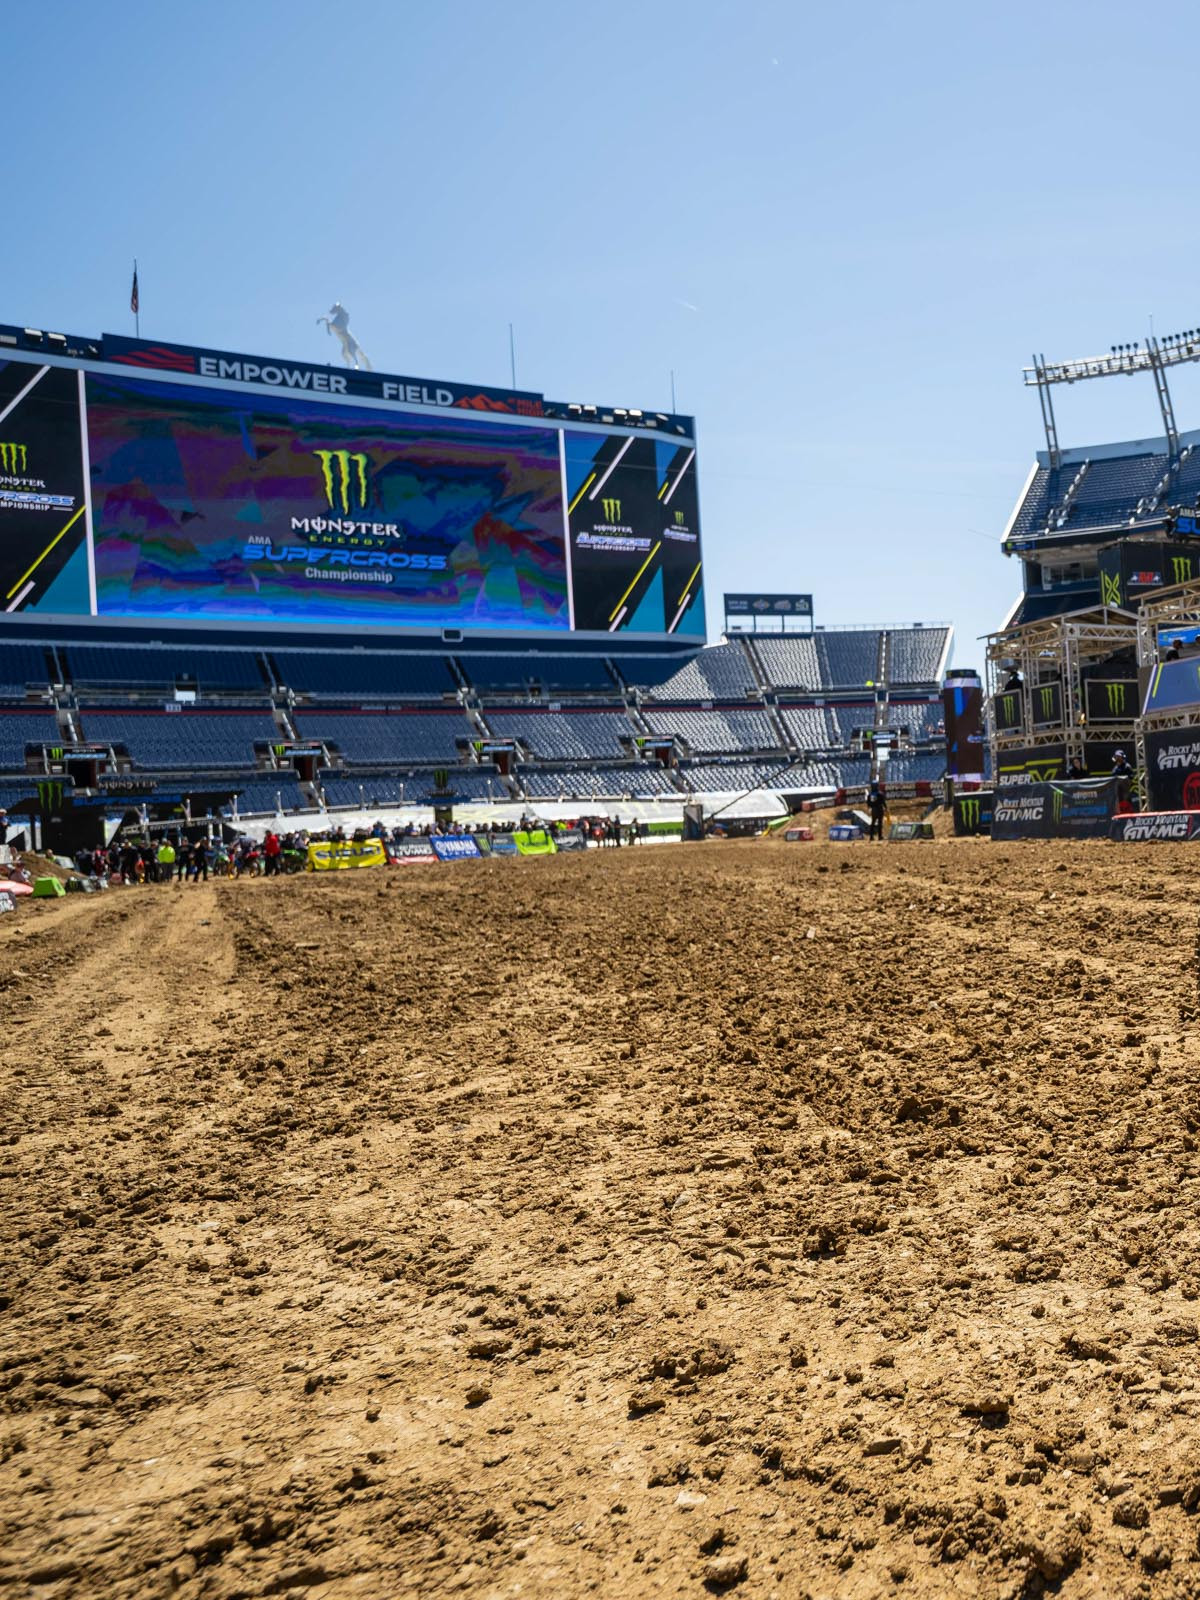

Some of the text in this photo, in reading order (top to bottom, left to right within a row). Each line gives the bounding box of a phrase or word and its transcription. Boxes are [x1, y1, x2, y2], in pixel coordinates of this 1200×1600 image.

[199, 356, 454, 407] EMPOWER FIELD
[291, 516, 400, 538] MONSTER
[248, 535, 272, 545] AMA
[242, 544, 447, 570] SUPERCROSS
[305, 567, 393, 583] Championship
[1000, 773, 1031, 786] SUPER
